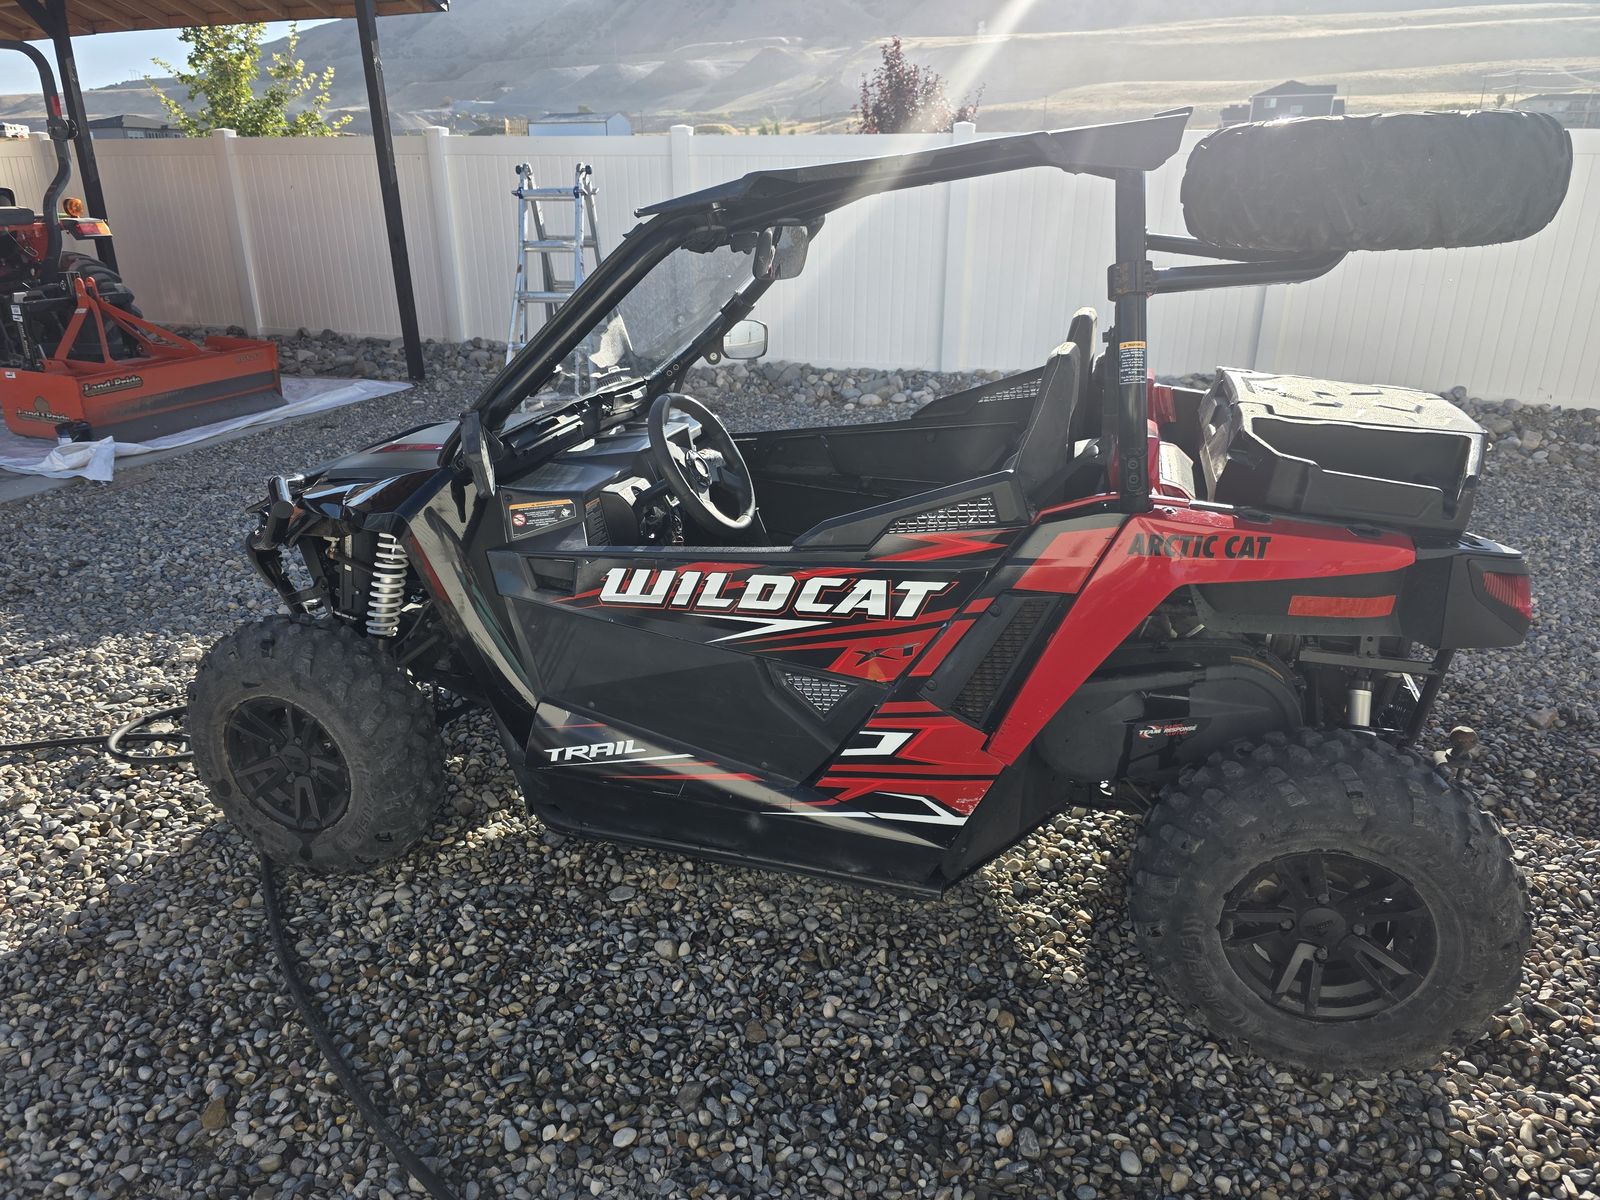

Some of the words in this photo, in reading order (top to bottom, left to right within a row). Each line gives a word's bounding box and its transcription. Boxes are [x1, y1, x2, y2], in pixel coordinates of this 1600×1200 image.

[1127, 533, 1218, 559] ARCTIC
[1225, 535, 1272, 559] CAT
[599, 567, 952, 618] WILDCAT
[1139, 727, 1162, 736] TEAM
[1163, 725, 1198, 733] RESPONSE
[544, 739, 647, 762] TRAIL
